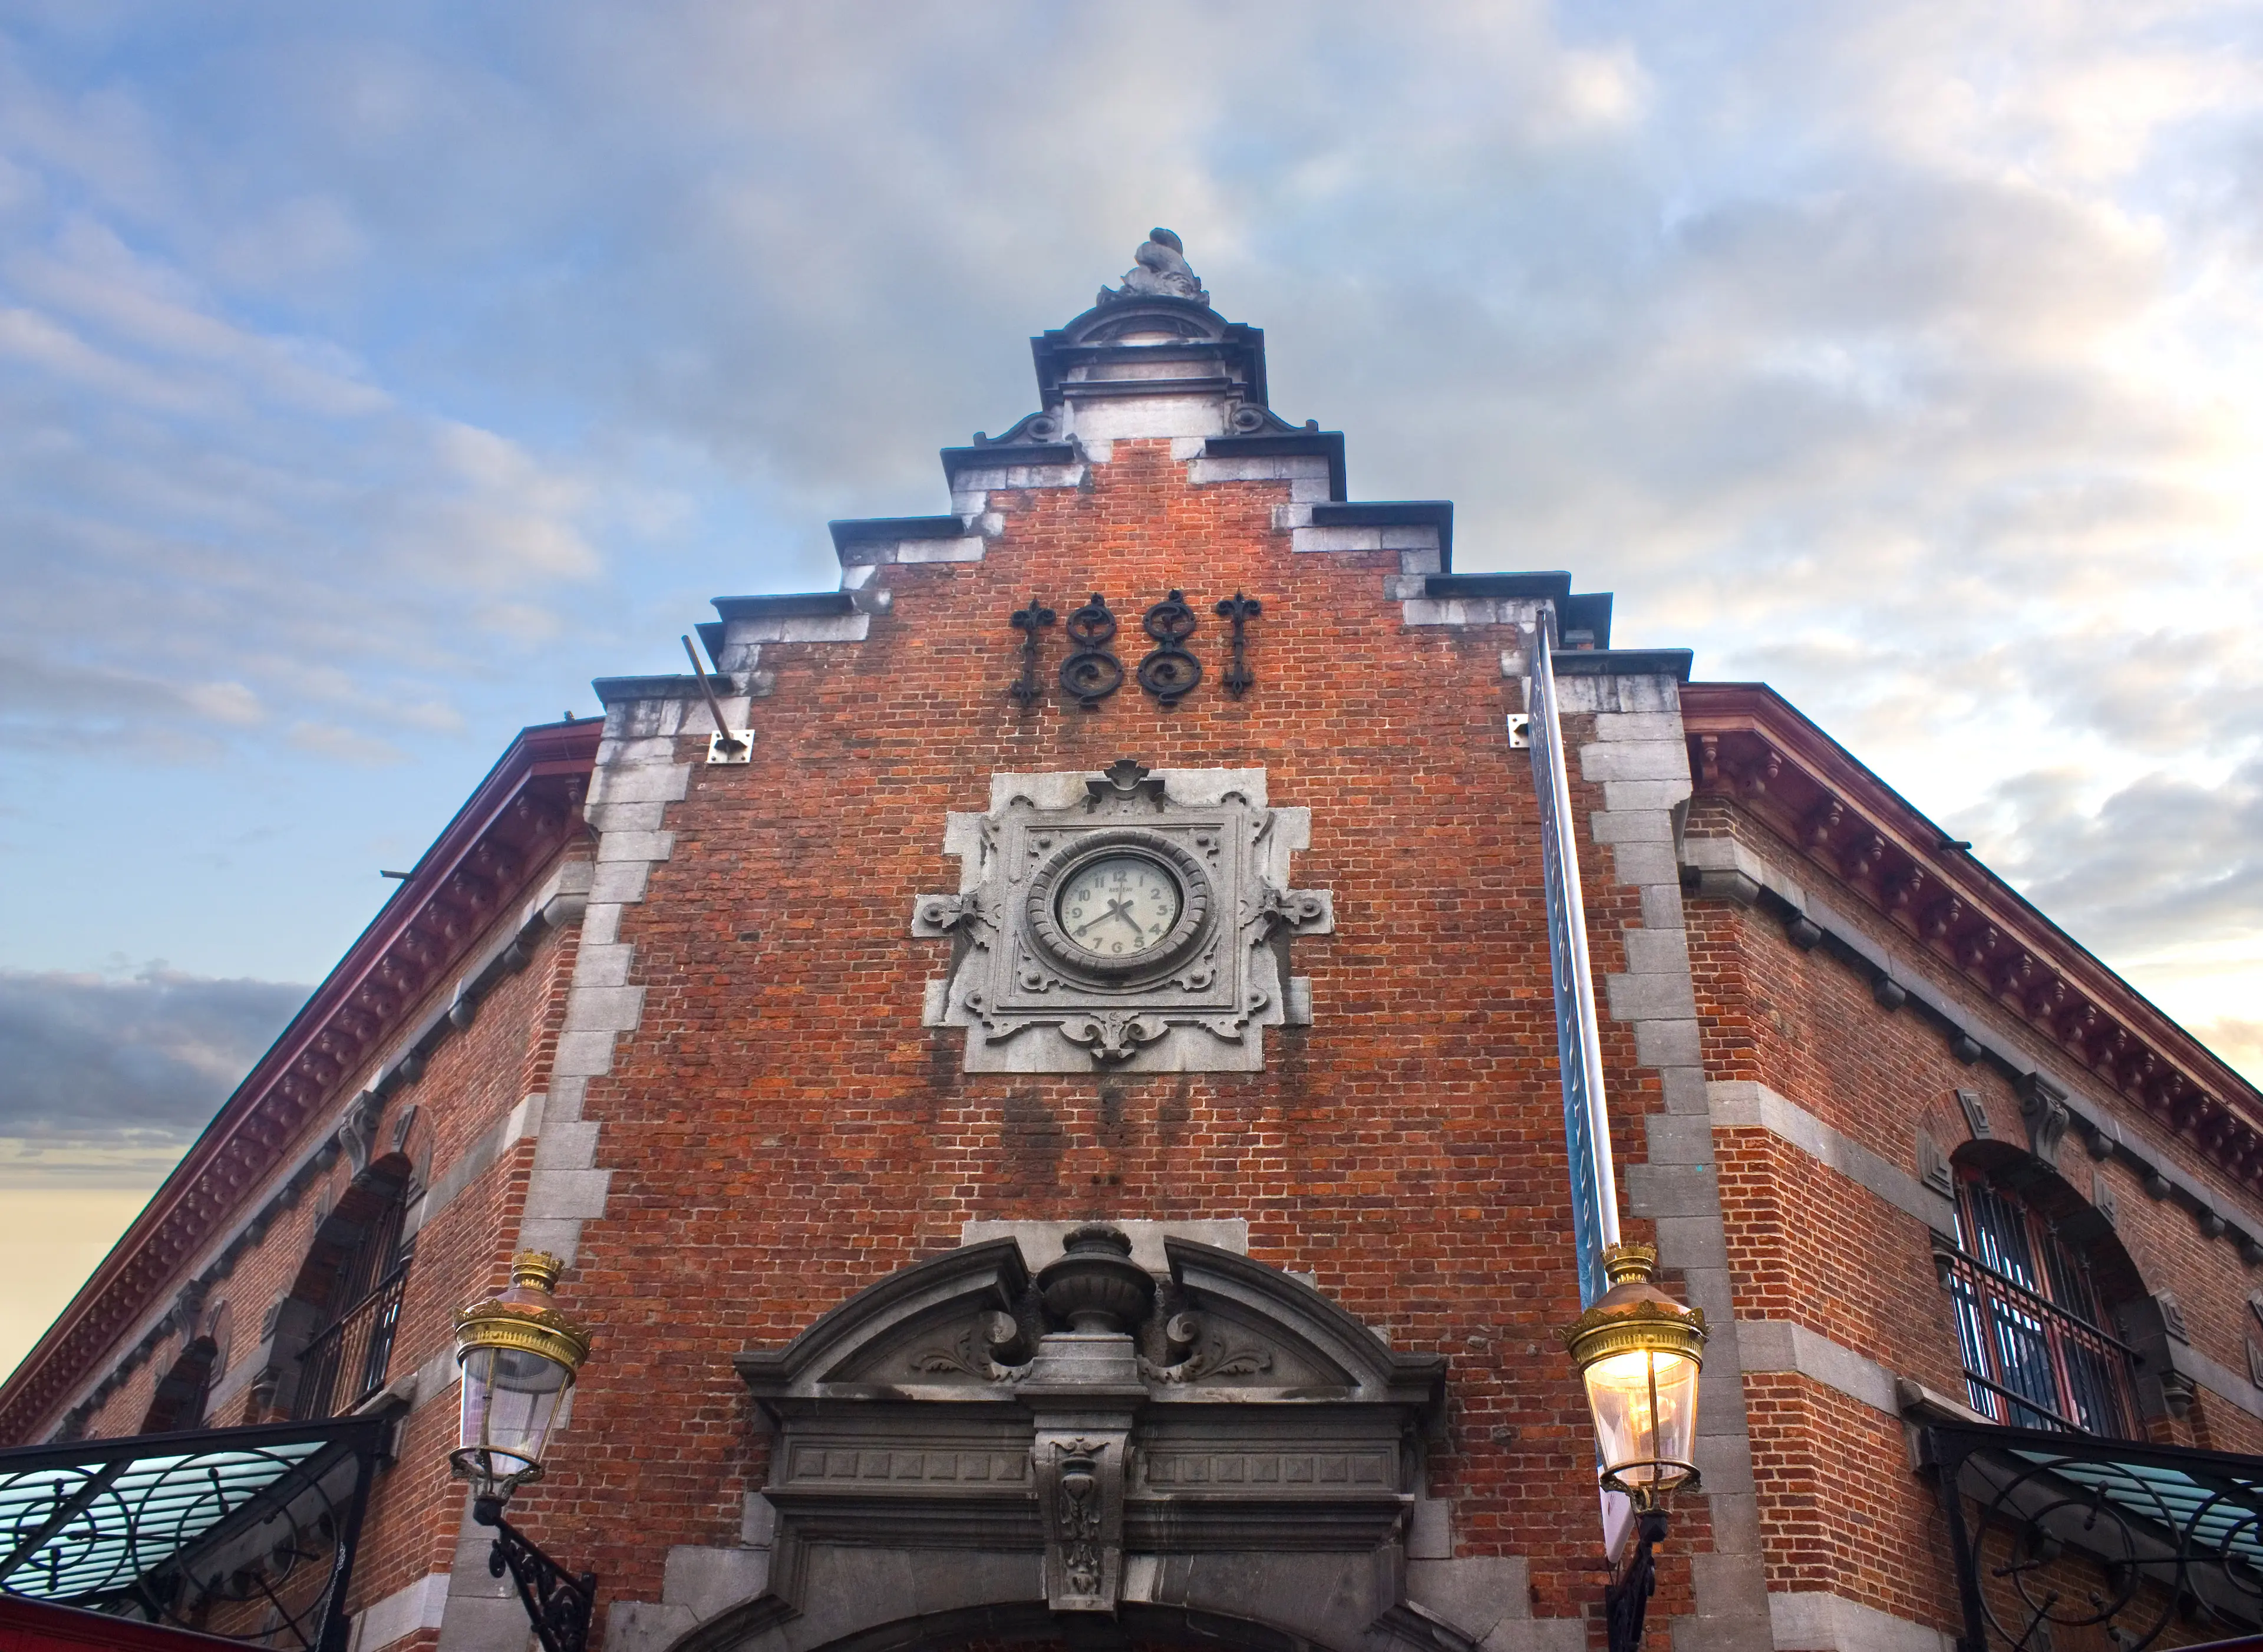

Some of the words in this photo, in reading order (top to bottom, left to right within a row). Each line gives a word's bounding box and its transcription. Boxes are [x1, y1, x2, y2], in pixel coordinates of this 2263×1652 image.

[1094, 876, 1104, 888] 11
[1113, 870, 1127, 882] 12
[1139, 875, 1144, 886] 1
[1078, 889, 1090, 902] 10
[1150, 888, 1161, 900] 2
[1071, 908, 1083, 918] 9
[1157, 905, 1167, 916] 3
[1149, 923, 1160, 935] 4
[1092, 937, 1103, 949] 7
[1111, 942, 1123, 954] 6
[1133, 937, 1144, 948] 5
